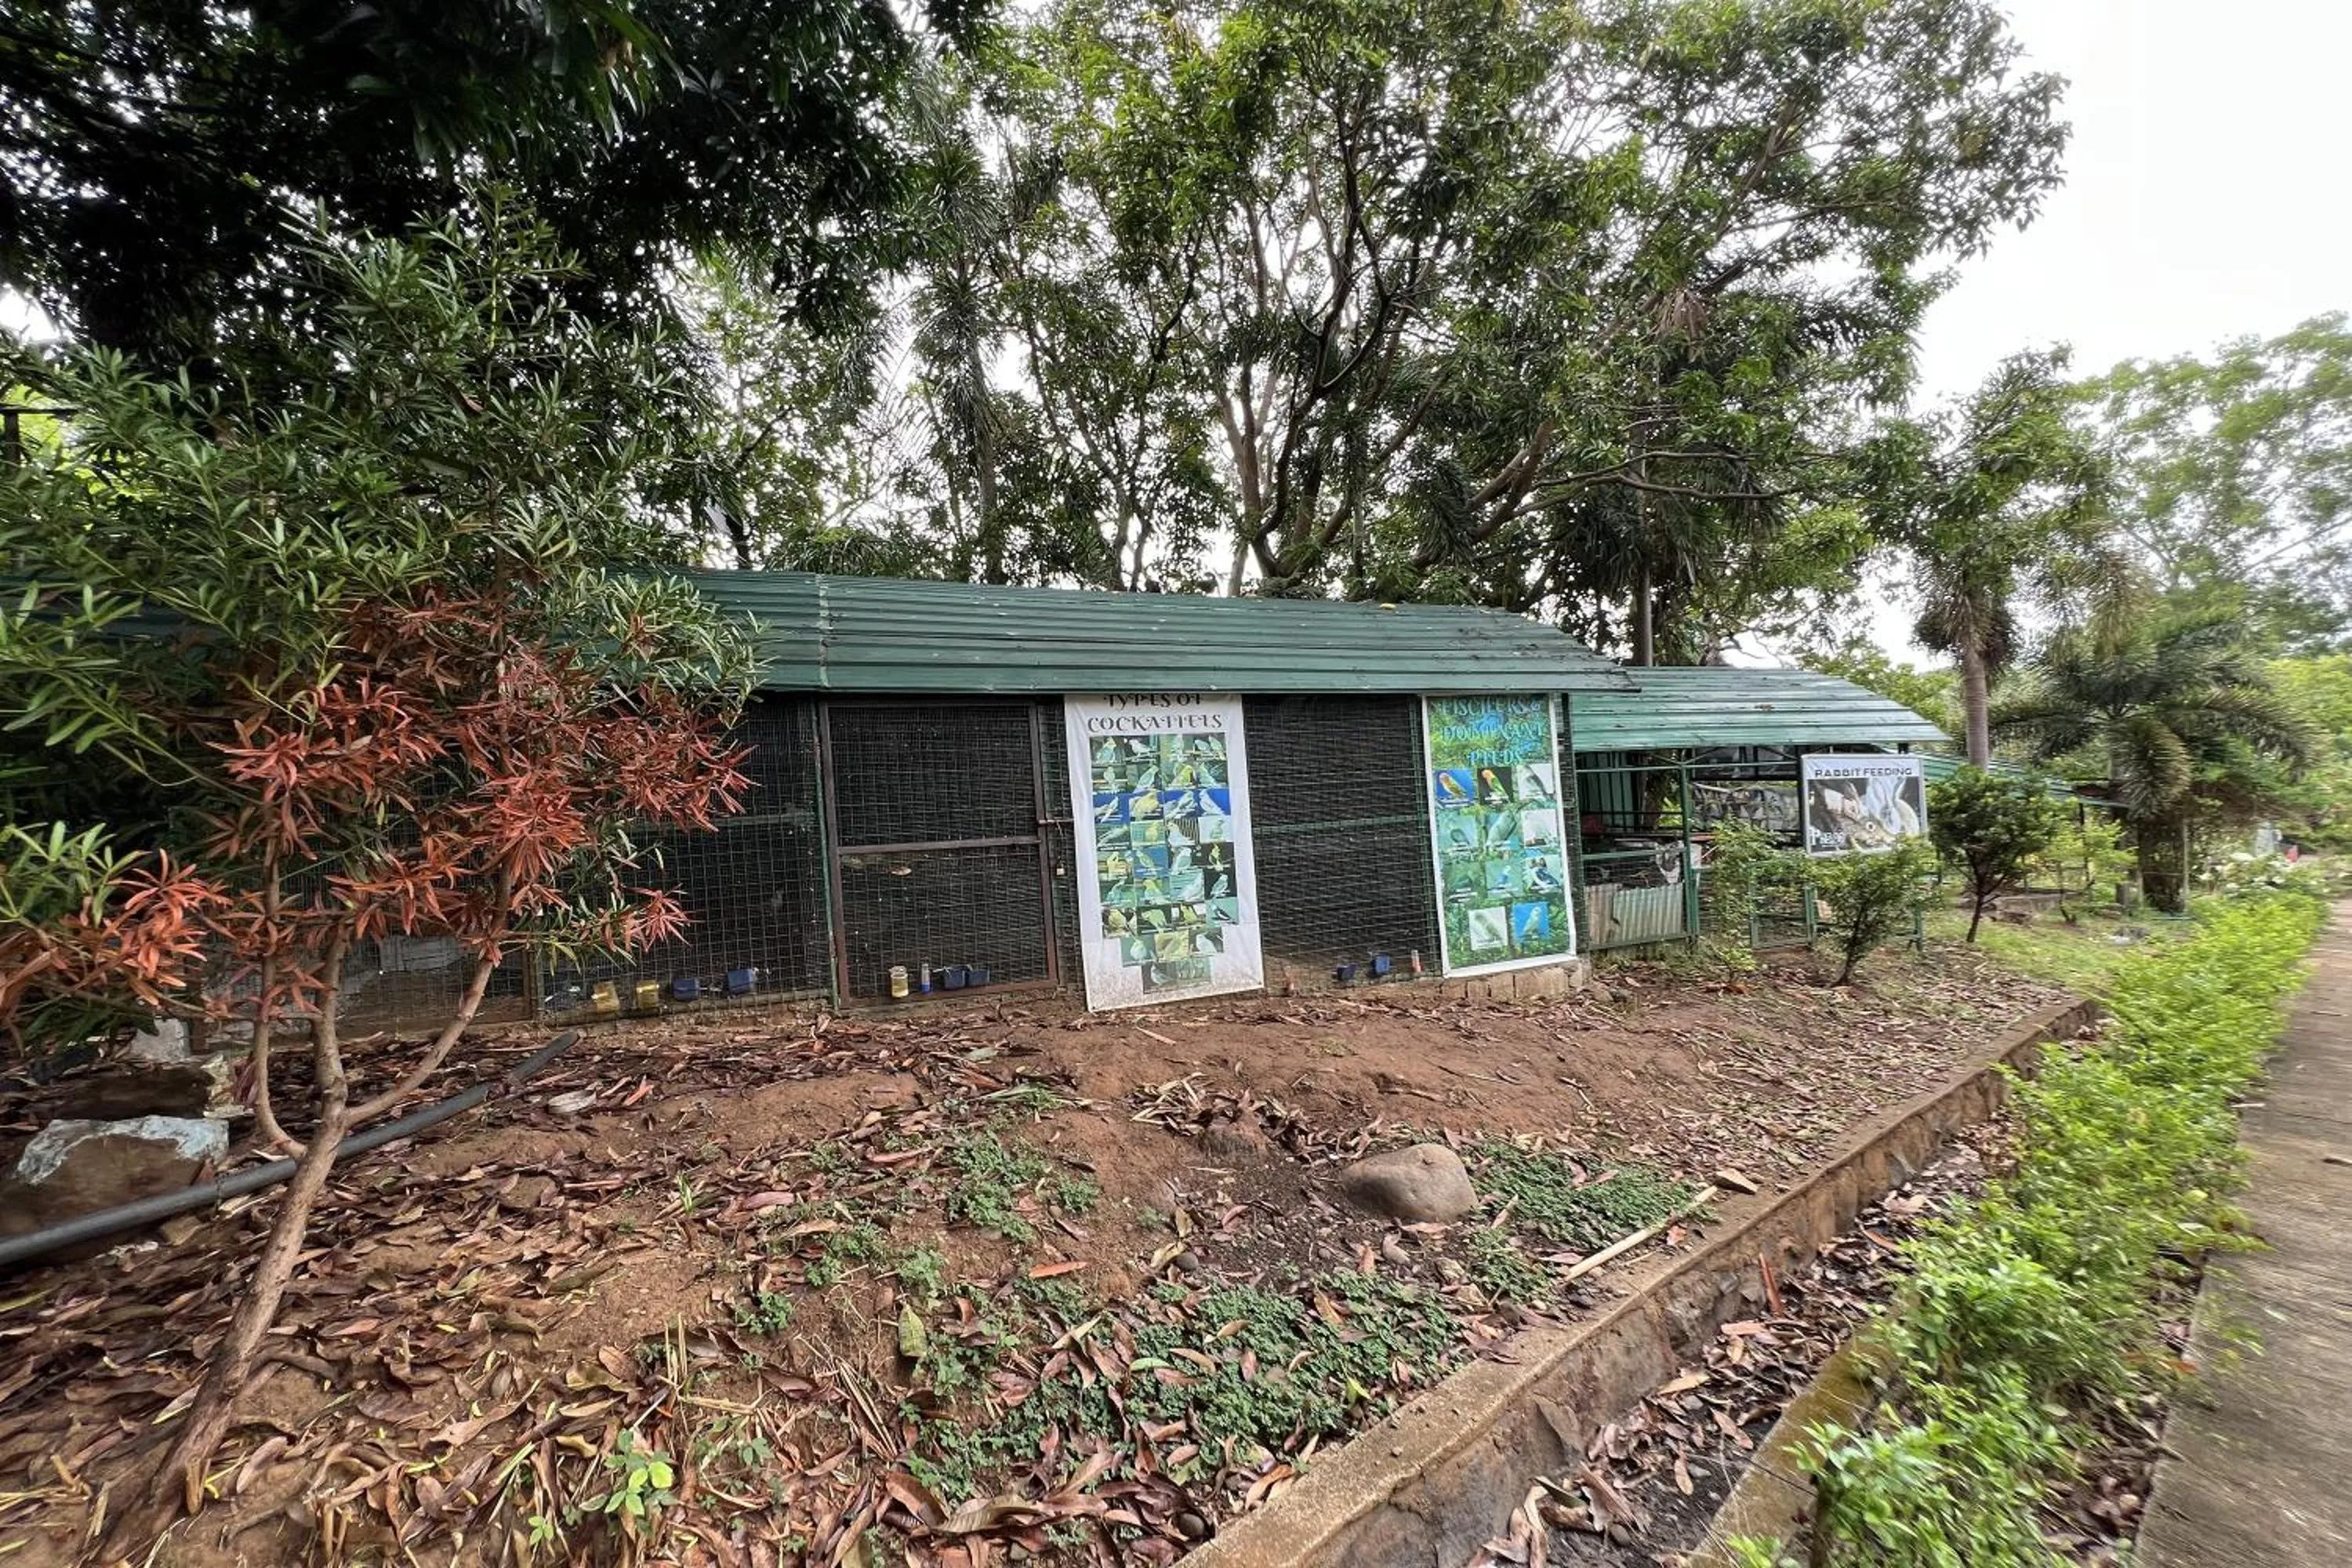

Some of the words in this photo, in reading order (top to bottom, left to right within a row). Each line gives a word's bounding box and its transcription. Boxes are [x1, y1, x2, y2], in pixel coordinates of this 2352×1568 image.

[1104, 693, 1171, 710] TYPES
[1177, 692, 1203, 706] OF
[1815, 768, 1860, 778] RABBIT
[1864, 768, 1912, 776] FEEDING
